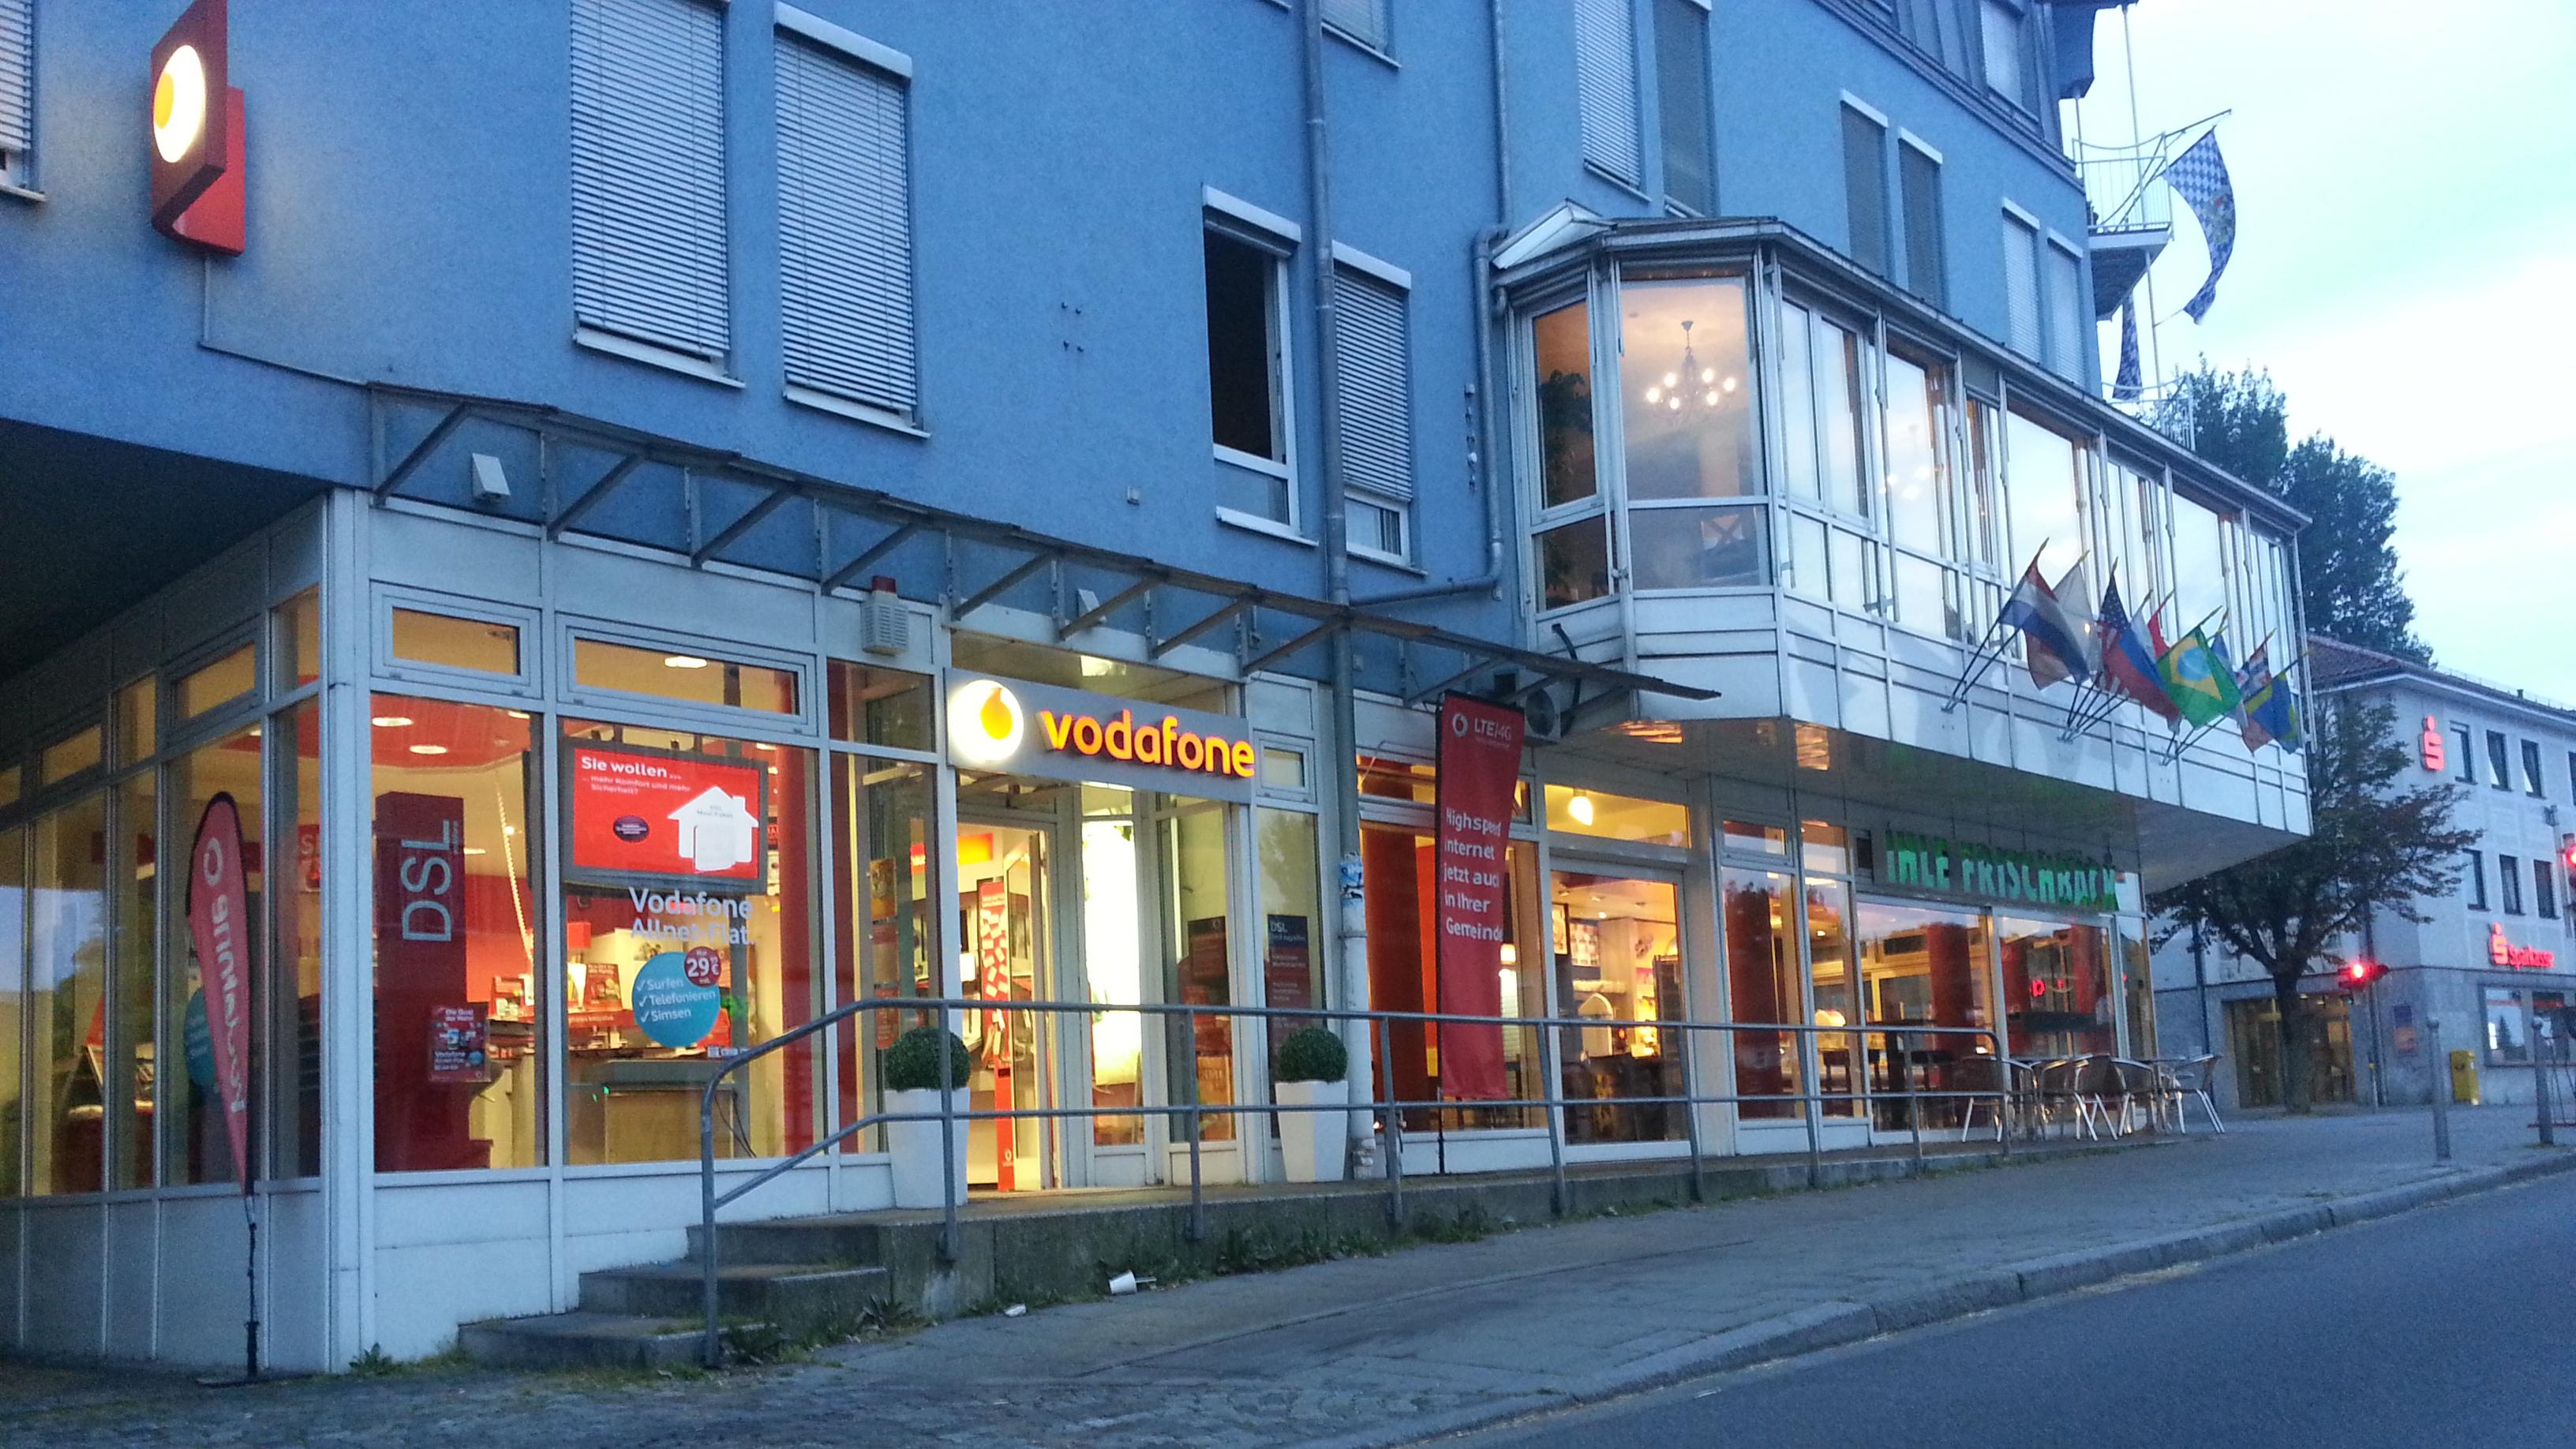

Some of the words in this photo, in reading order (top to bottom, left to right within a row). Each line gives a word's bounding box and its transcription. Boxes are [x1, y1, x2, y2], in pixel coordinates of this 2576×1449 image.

[1039, 709, 1255, 778] vodafone
[581, 756, 607, 771] Sie
[611, 762, 668, 779] wollen
[400, 819, 452, 942] DSL
[1443, 862, 1470, 885] jetzt
[1473, 868, 1500, 888] auc
[628, 886, 755, 919] Vodafone
[1444, 889, 1456, 907] in
[1457, 892, 1491, 913] Ihrer
[1269, 921, 1289, 933] DSL
[686, 957, 710, 978] 29
[646, 977, 684, 990] Surfen
[649, 988, 717, 1006] Telefonieren
[651, 1007, 692, 1023] Simsen
